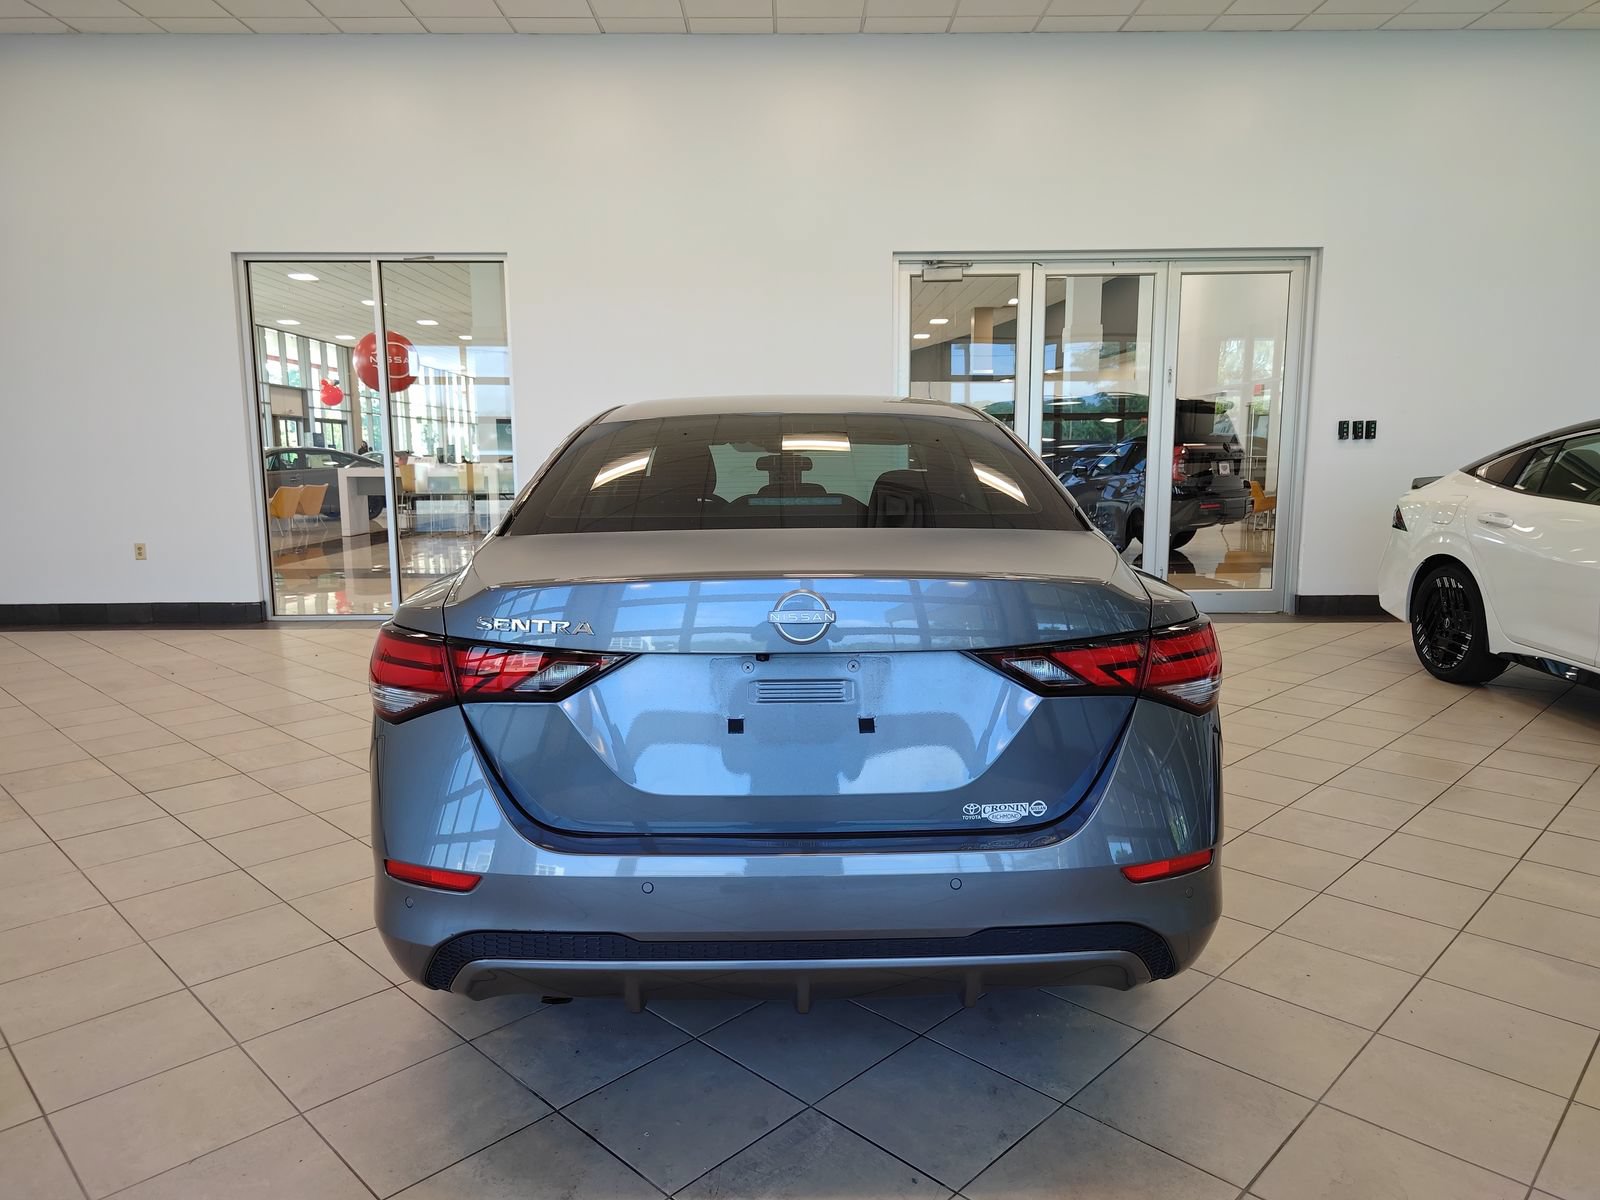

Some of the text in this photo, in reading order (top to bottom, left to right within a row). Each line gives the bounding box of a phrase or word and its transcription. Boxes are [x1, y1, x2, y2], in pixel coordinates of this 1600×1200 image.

[770, 613, 834, 621] NISSAN
[476, 616, 595, 636] SENTRA
[983, 804, 1027, 815] CRONIN
